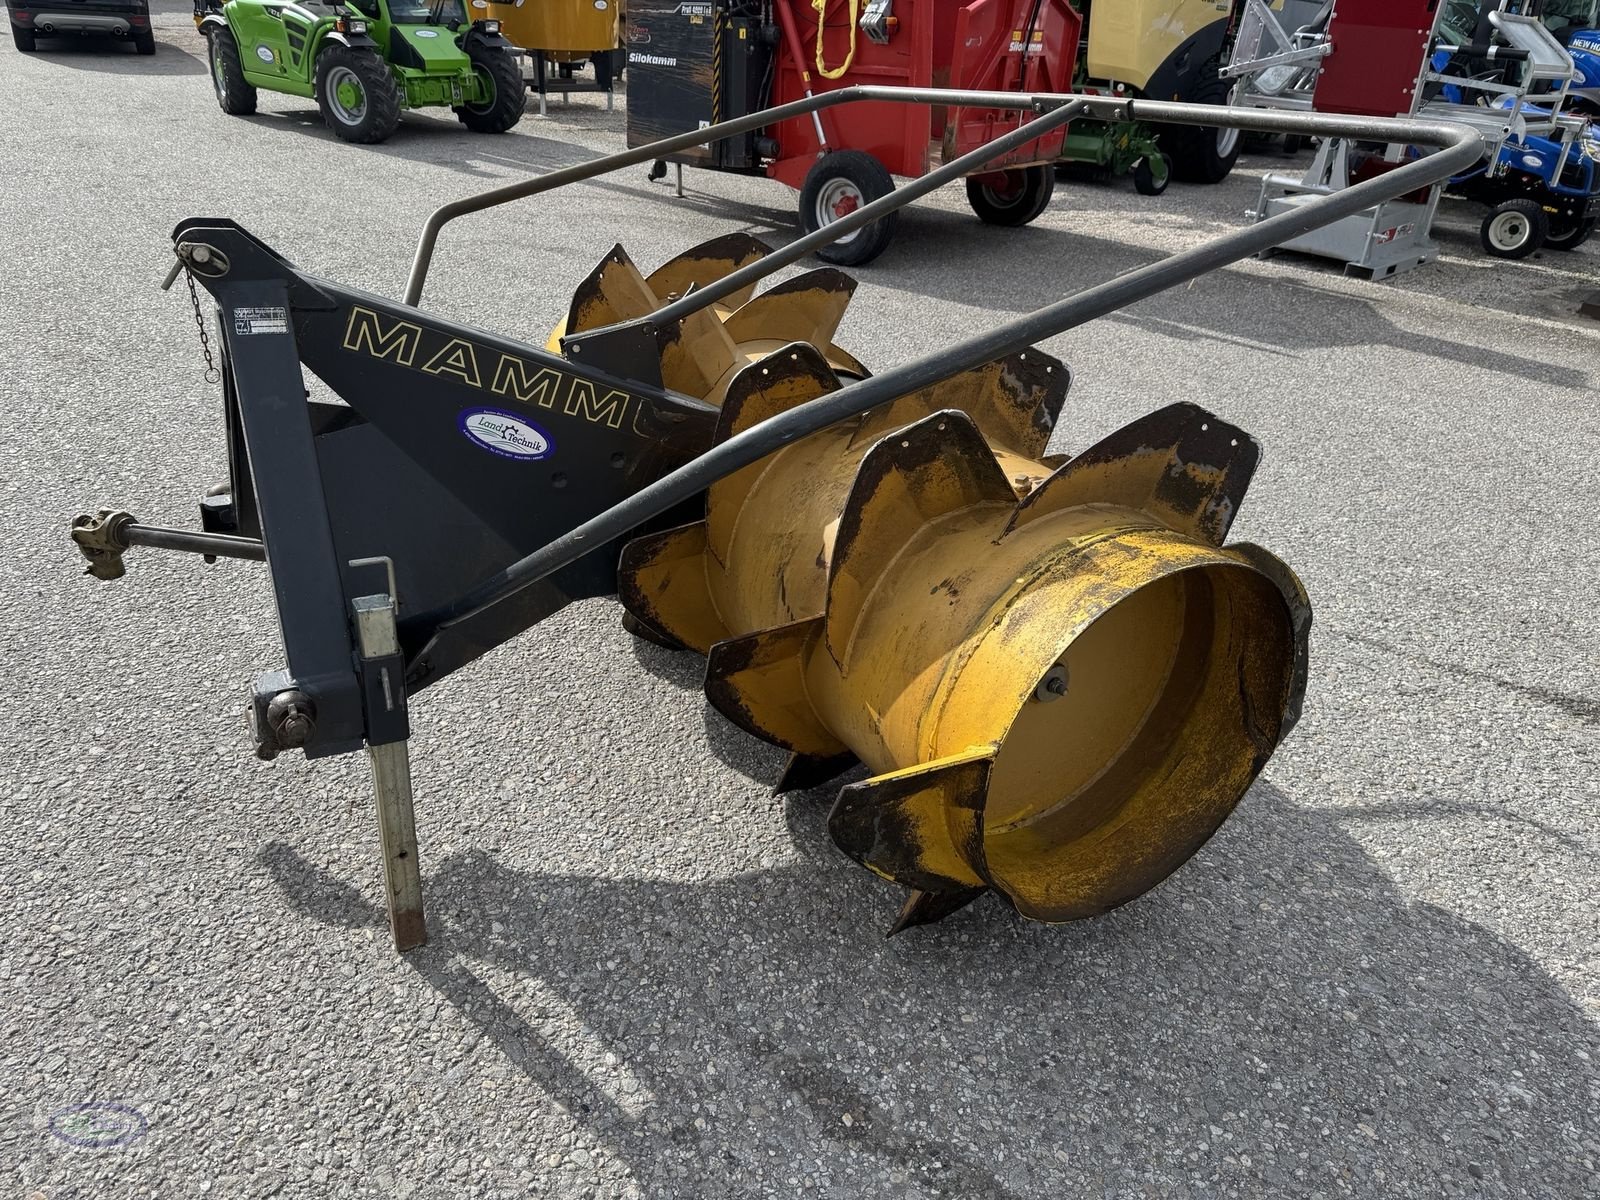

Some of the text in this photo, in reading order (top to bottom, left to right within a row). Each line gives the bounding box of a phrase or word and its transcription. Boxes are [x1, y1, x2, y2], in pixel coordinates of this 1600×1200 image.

[1573, 38, 1591, 49] NEW
[629, 52, 677, 67] Silokamm
[478, 416, 503, 433] Land
[508, 432, 542, 451] Technik
